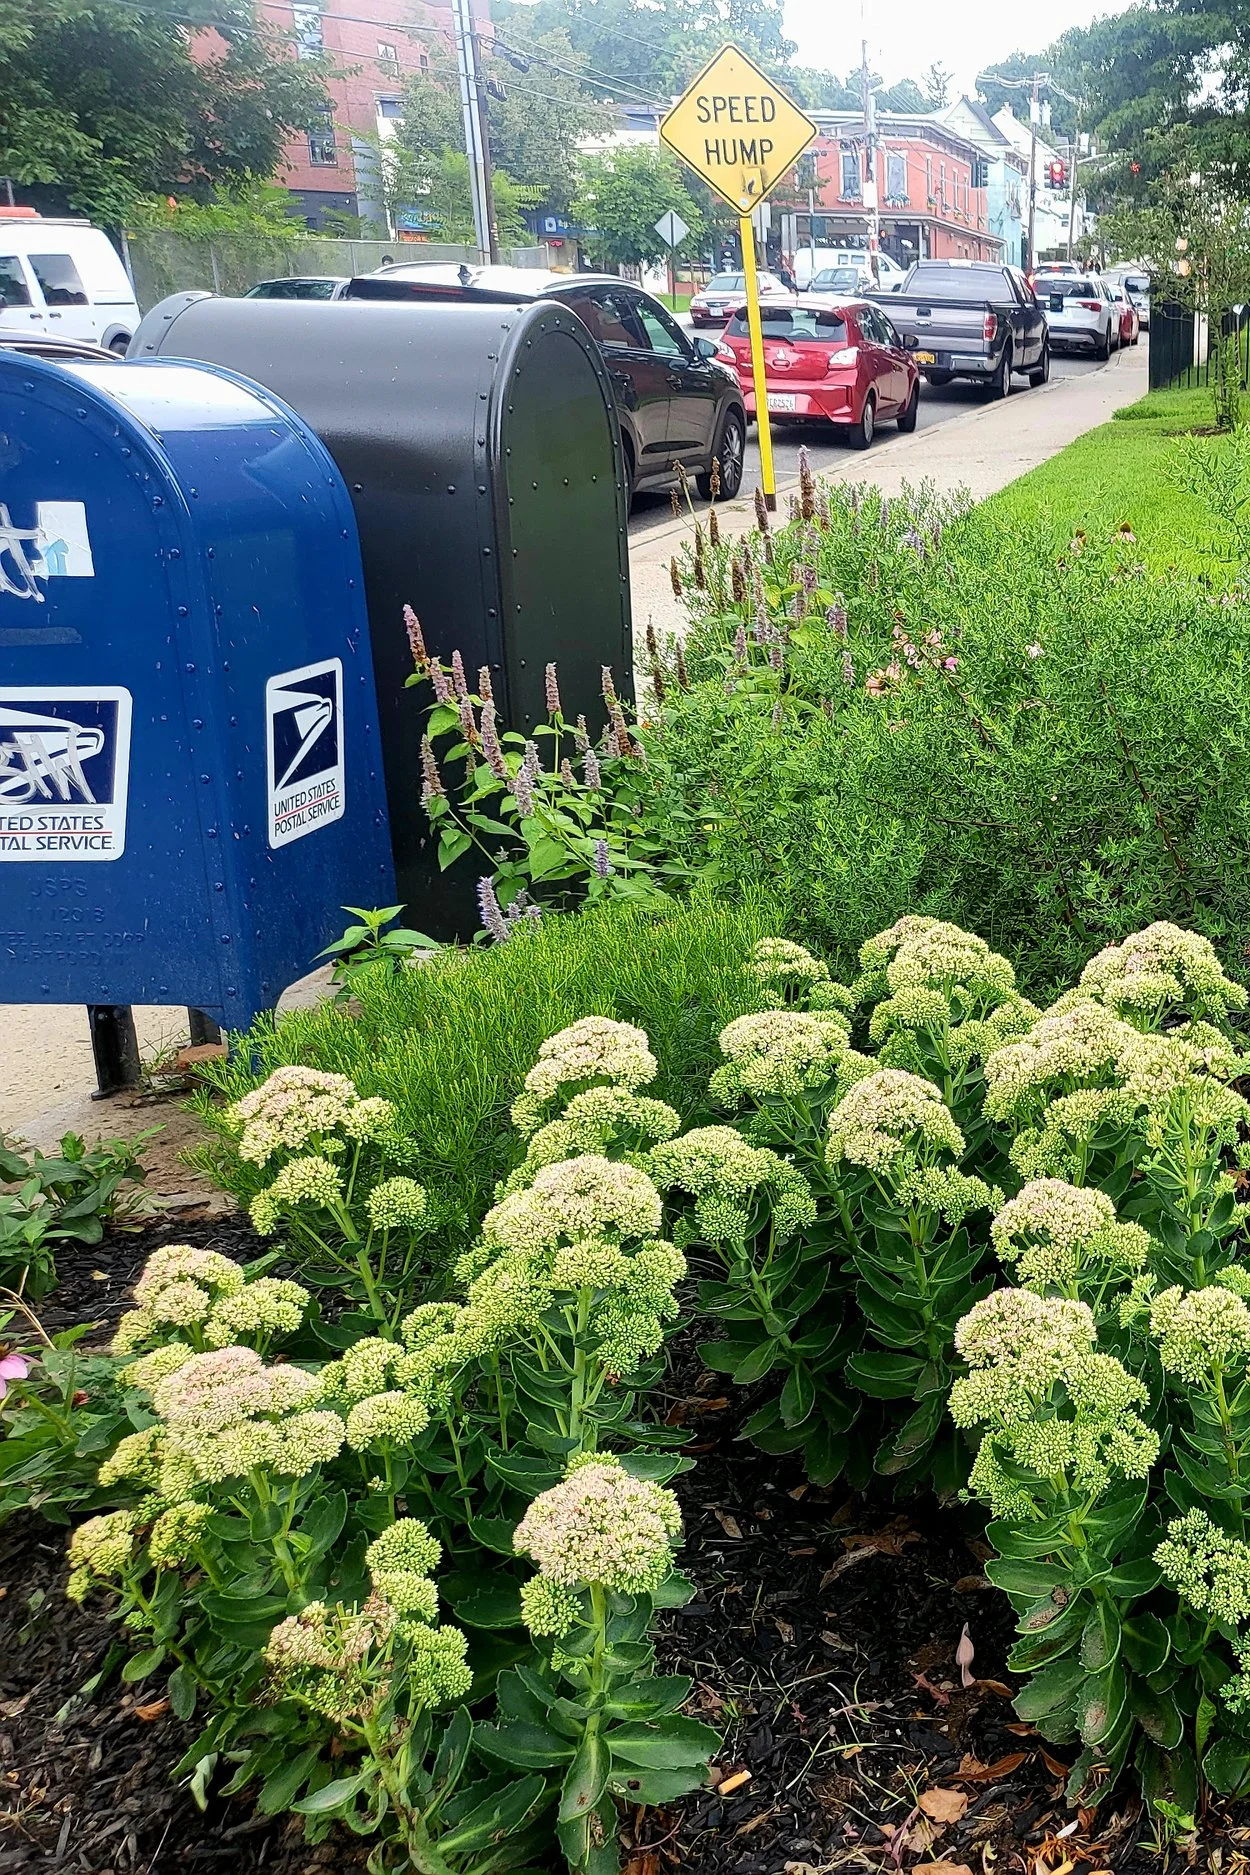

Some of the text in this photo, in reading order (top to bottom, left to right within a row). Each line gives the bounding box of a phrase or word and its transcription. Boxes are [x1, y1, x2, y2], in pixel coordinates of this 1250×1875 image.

[696, 95, 776, 123] SPEED
[704, 138, 774, 165] HUMP
[274, 778, 336, 816] UNITED STATES
[37, 815, 104, 831] STATES
[275, 795, 340, 837] POSTAL SERVICE
[0, 836, 32, 851] TAL
